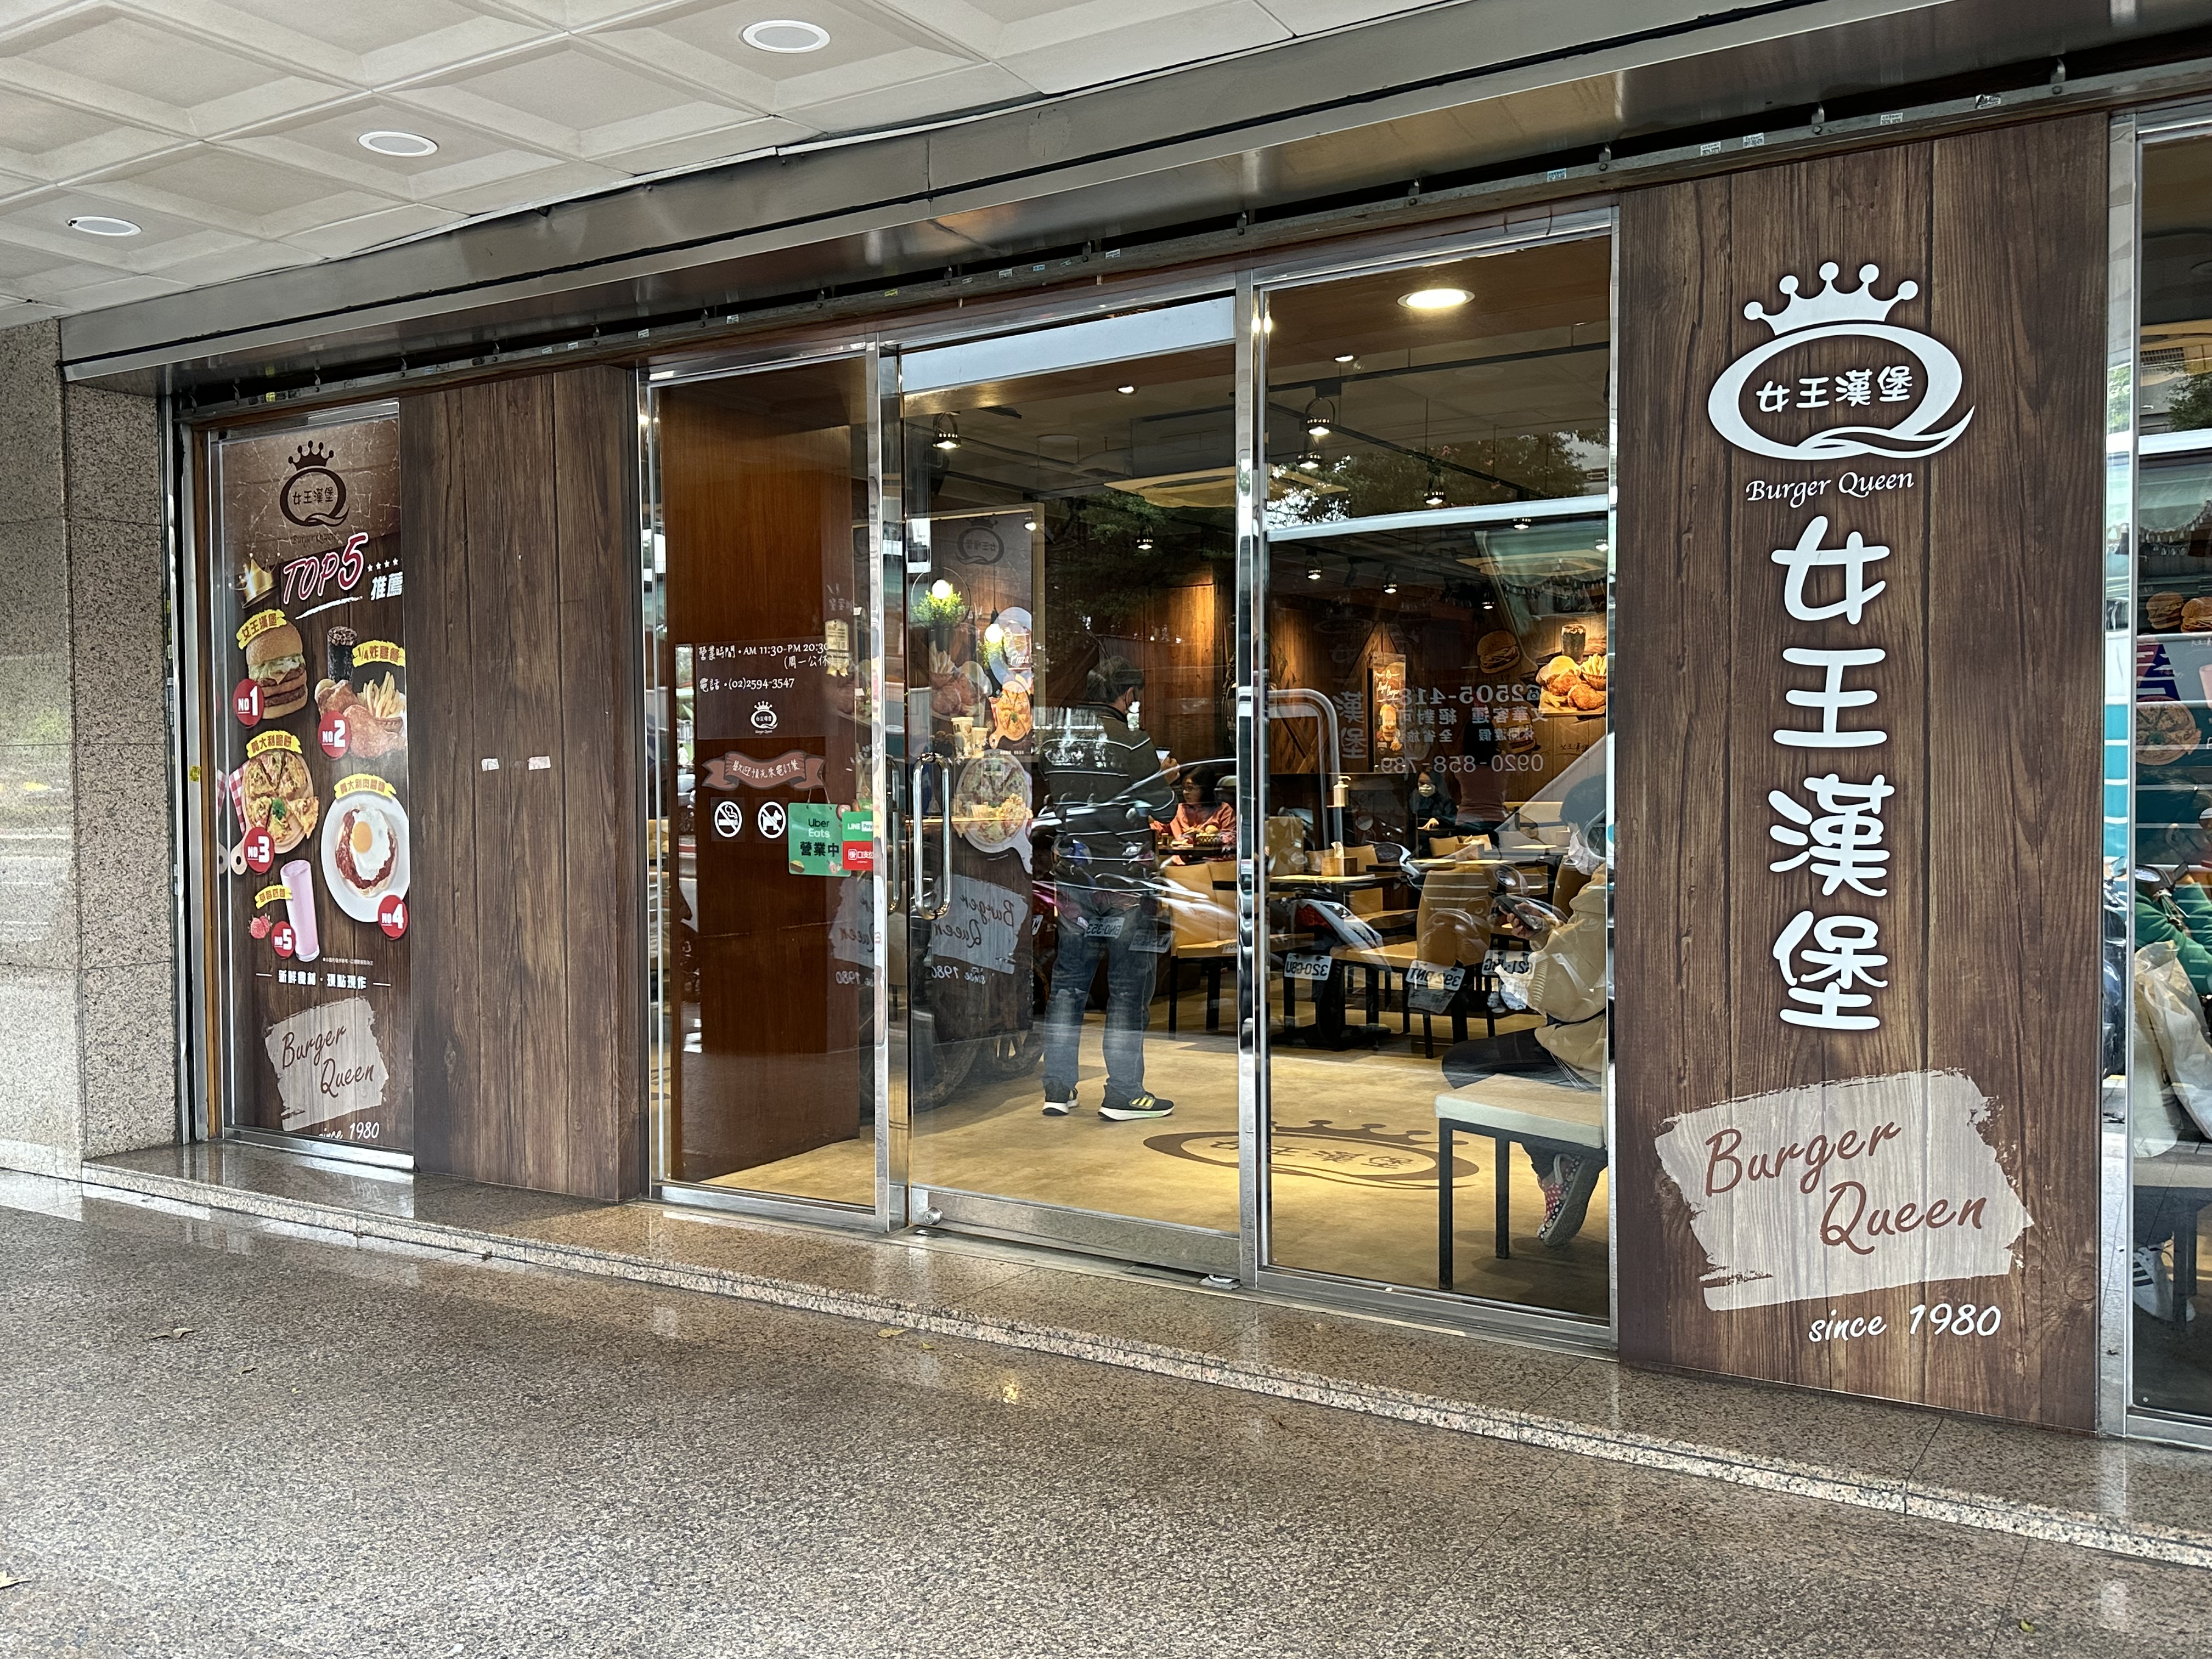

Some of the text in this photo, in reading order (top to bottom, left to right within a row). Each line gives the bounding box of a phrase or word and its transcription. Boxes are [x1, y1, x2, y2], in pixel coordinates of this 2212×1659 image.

[1756, 365, 1914, 413] 女王漢堡
[292, 487, 334, 505] 女王漢堡
[1746, 471, 1915, 508] Burger Queen
[371, 572, 403, 601] 推薦
[698, 645, 735, 661] 營業時間
[743, 646, 757, 656] AM
[1010, 650, 1029, 665] Pizza
[729, 676, 795, 691] (02)2594-3547
[1768, 516, 1895, 1030] 女王漢堡
[808, 818, 830, 827] Uber
[808, 828, 830, 838] Eats
[800, 841, 839, 857] 營業中
[278, 969, 316, 985] 新鮮食材
[282, 1025, 347, 1070] Burger
[320, 1058, 374, 1098] Queen
[349, 1122, 380, 1139] 1980
[1705, 1121, 1901, 1197] Burger
[1819, 1181, 1987, 1255] Queen
[1808, 1303, 2001, 1342] since 1980
